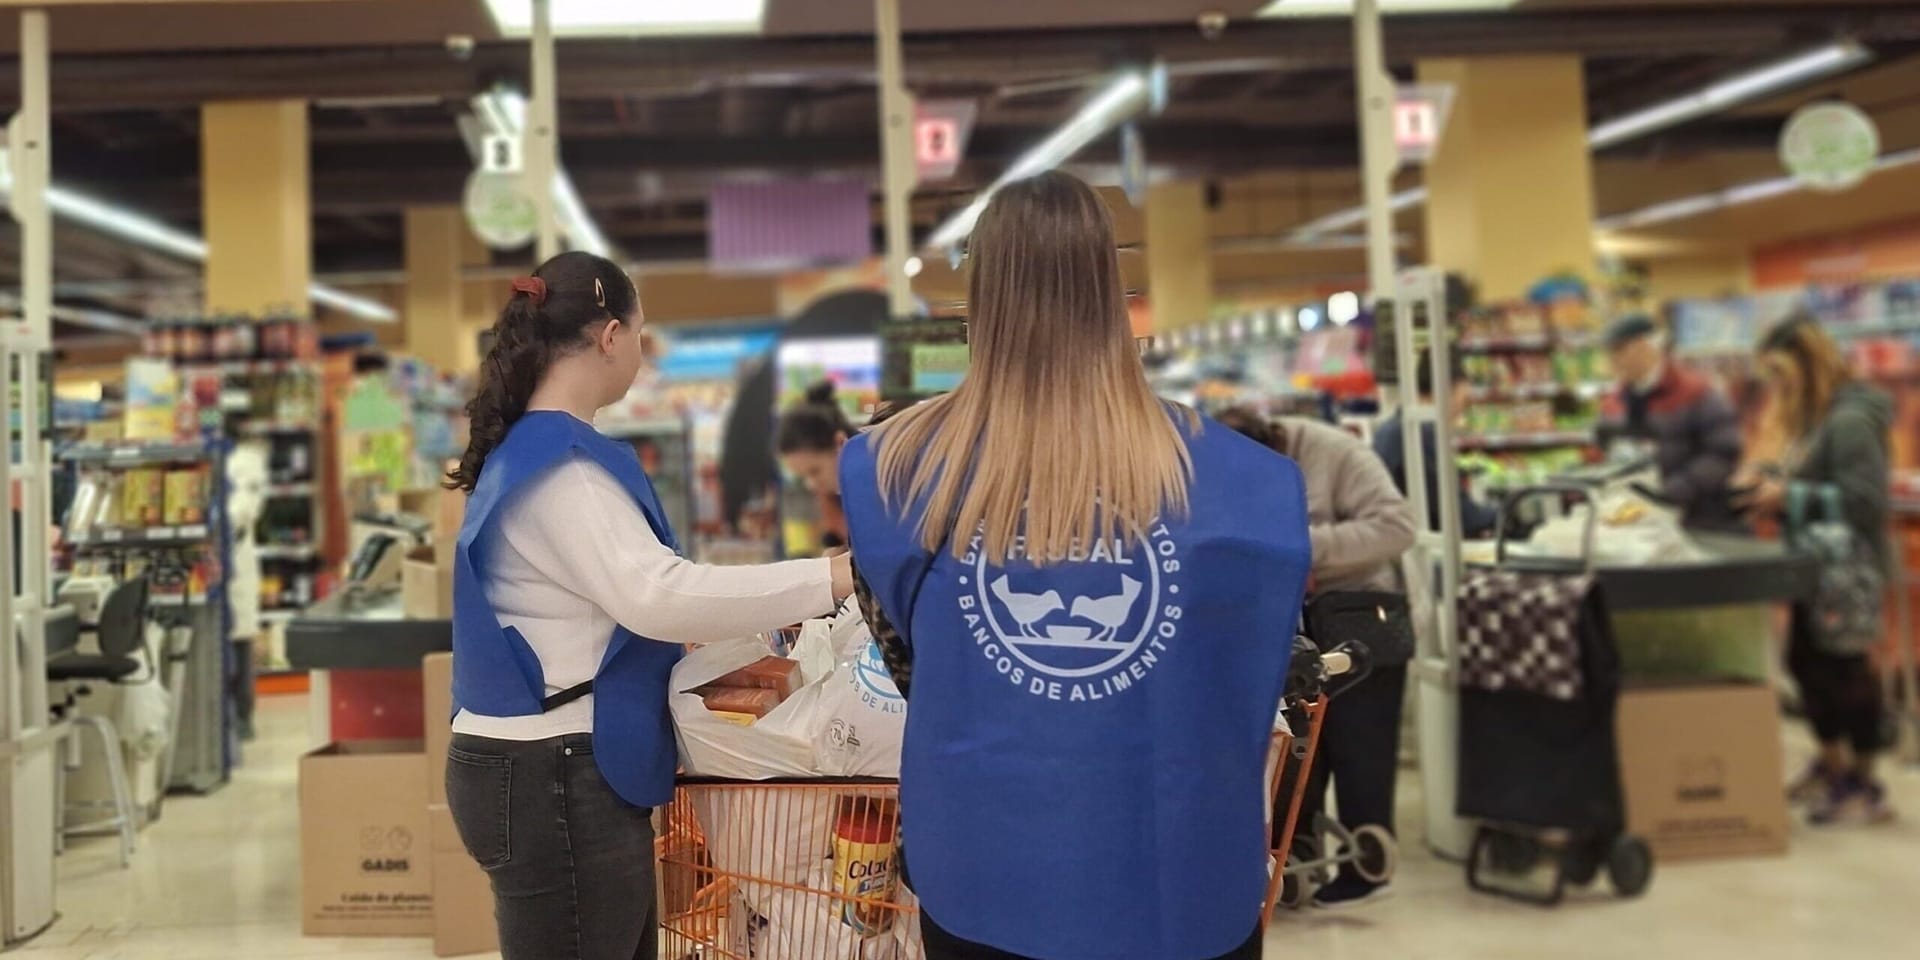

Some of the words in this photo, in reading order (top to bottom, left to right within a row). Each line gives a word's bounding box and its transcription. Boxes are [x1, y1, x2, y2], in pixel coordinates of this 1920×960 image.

[958, 594, 1025, 686] BANCOS
[1029, 676, 1062, 700] DE
[1069, 603, 1183, 702] ALIMENTOS
